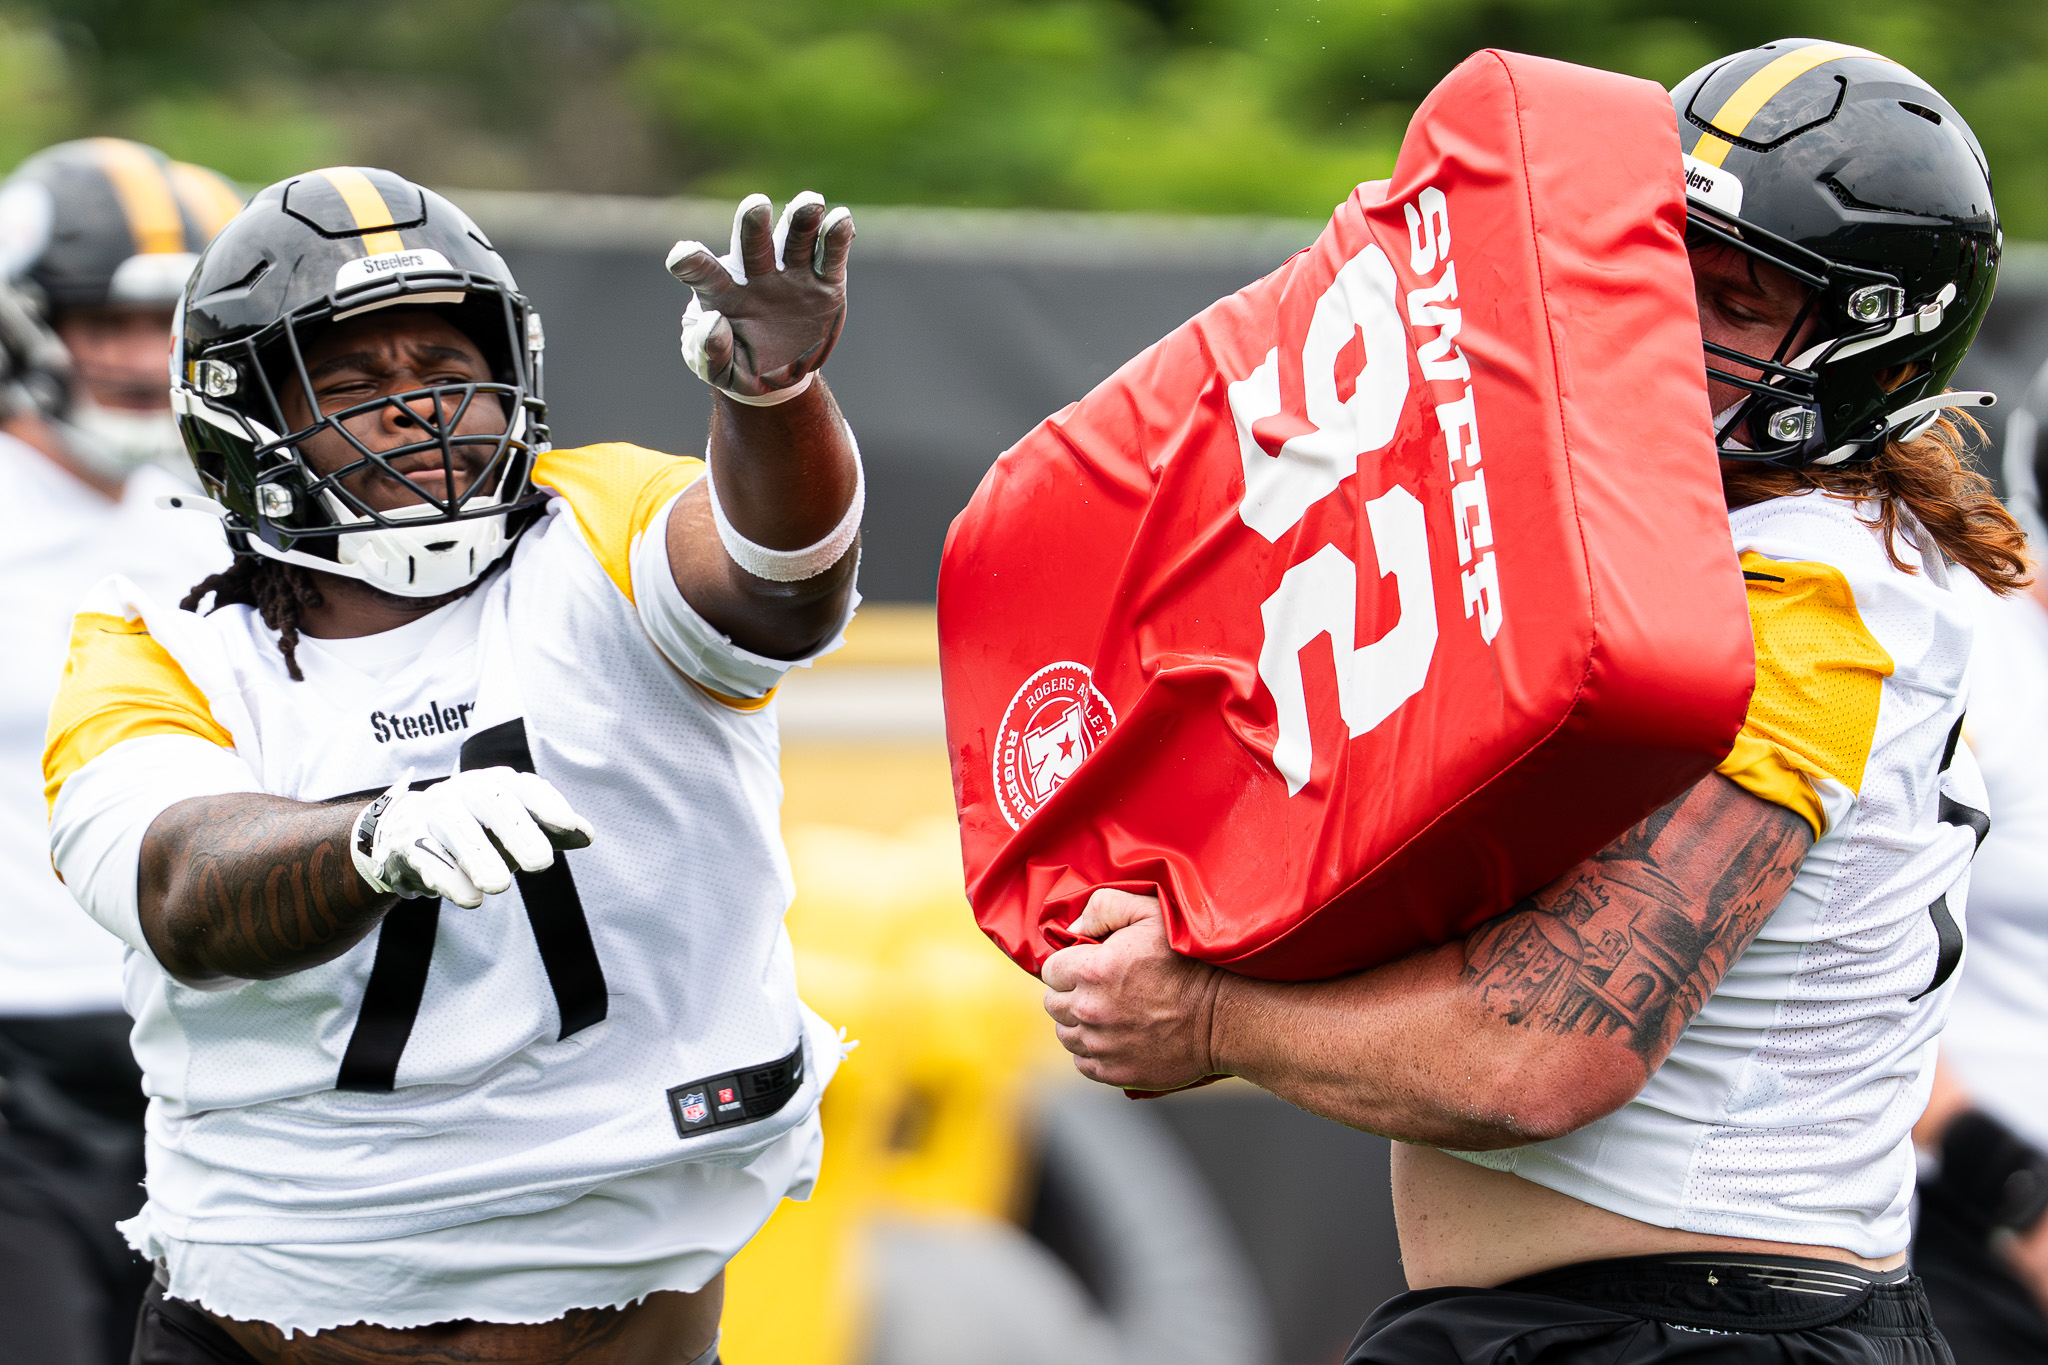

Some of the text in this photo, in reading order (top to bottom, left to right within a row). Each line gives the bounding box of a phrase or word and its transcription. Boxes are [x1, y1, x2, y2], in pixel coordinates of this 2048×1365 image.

[363, 254, 424, 274] Steelers
[1404, 186, 1503, 647] SWEEP
[1228, 242, 1438, 798] 92
[370, 700, 476, 744] Steeler
[1025, 677, 1076, 710] ROGERS
[1004, 729, 1035, 820] ROGERS
[357, 794, 393, 858] NIKE
